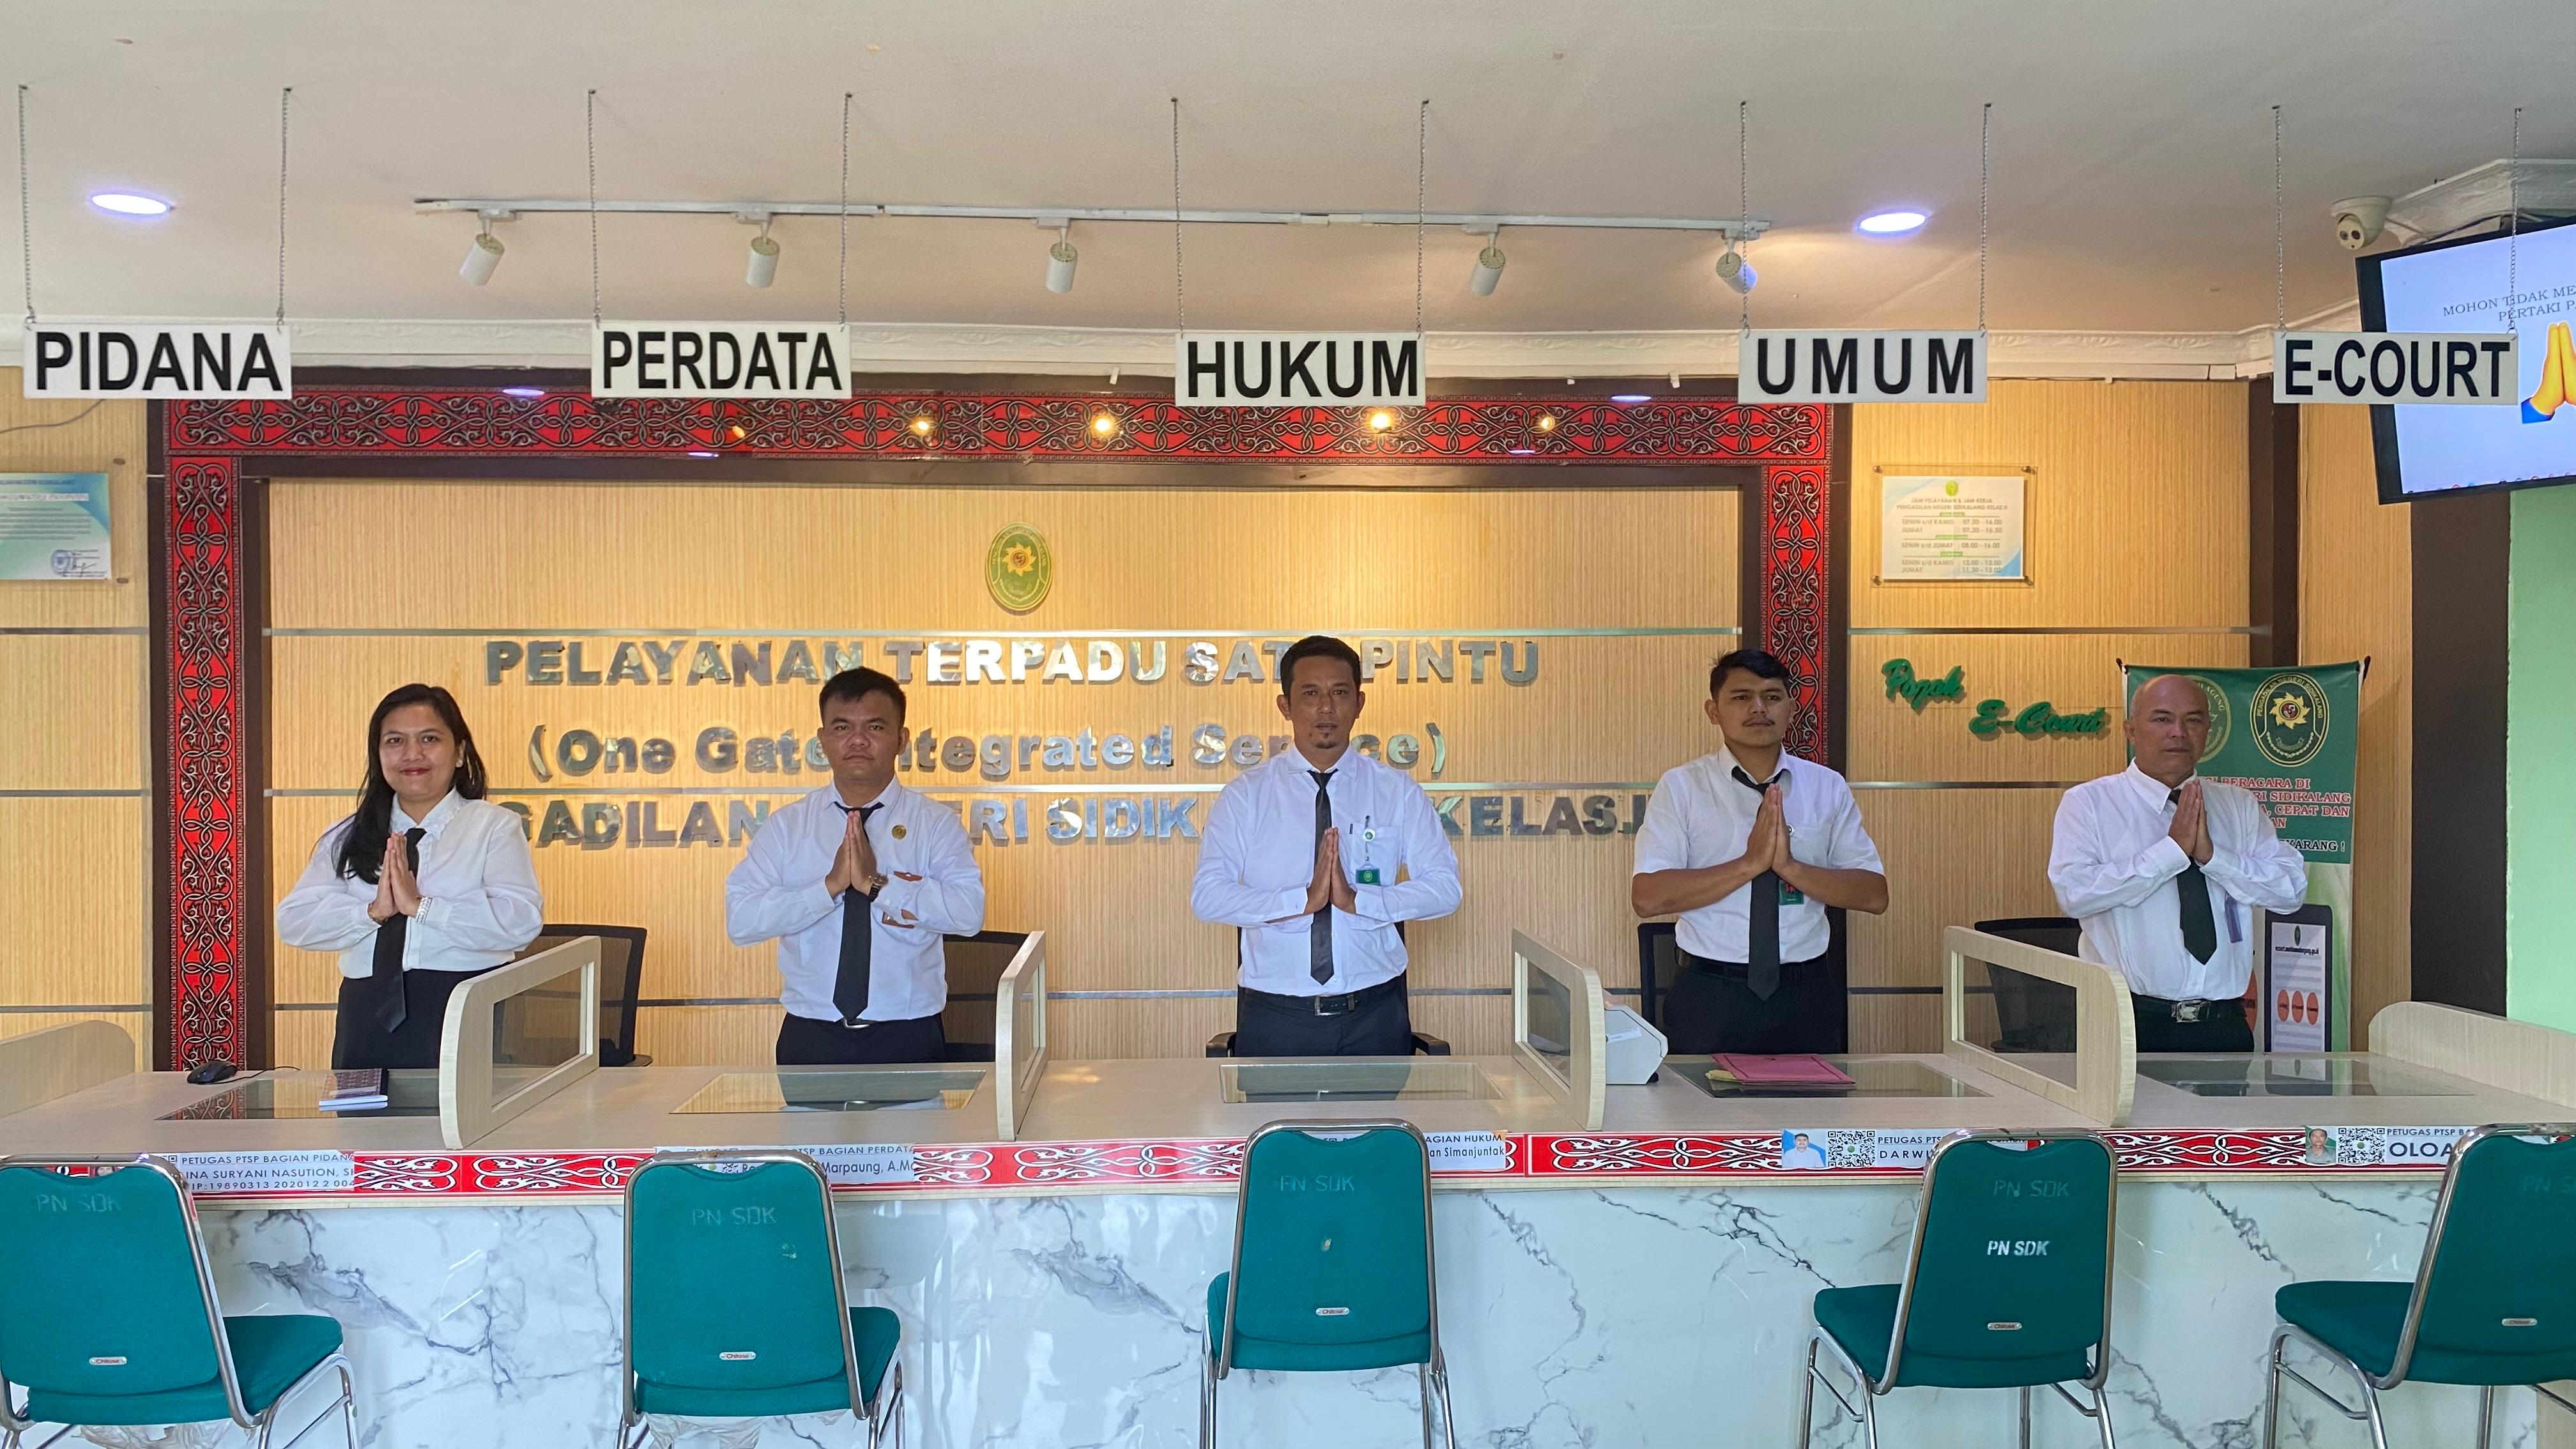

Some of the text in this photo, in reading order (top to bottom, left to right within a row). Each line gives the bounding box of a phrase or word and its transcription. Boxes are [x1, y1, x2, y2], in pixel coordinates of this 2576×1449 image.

[2443, 298, 2498, 316] MOHON
[2503, 289, 2548, 307] TIDAK
[2499, 300, 2576, 321] PERTAKI P
[36, 332, 283, 392] PIDANA
[603, 331, 842, 390] PERDATA
[1188, 340, 1417, 399] HUKUM
[1758, 338, 1974, 395] UMUM
[2285, 339, 2510, 397] E-COURT
[486, 640, 1539, 686] PELAYANAN TERPADU SAT PINTU
[2257, 681, 2279, 717] PENGADILAN
[2304, 682, 2324, 719] SIDIKALANG
[528, 724, 676, 782] (One
[1192, 723, 1446, 774] Serce)
[2221, 777, 2292, 789] BERACARA
[2295, 778, 2310, 790] DI
[2270, 792, 2351, 803] SIDIKALANG
[2274, 805, 2319, 816] CEPAT
[2321, 806, 2350, 817] DAN
[1046, 797, 1201, 845] SIDIK
[1464, 1134, 1502, 1142] HUKUM
[819, 1147, 864, 1155] BAGIAN
[1445, 1146, 1505, 1159] Simanjuntak
[1879, 1150, 1929, 1158] DARWI
[2389, 1142, 2453, 1157] OLOA
[181, 1156, 231, 1165] PETUGAS
[235, 1155, 259, 1164] PTSP
[263, 1154, 309, 1163] BAGIAN
[212, 1169, 267, 1179] SURYANI
[272, 1167, 339, 1177] NASUTION,
[192, 1181, 270, 1190] IP:19890313
[1993, 1179, 2069, 1197] PN SDK
[36, 1193, 68, 1212] PN
[691, 1206, 777, 1226] PN SDK
[1987, 1240, 2051, 1257] PN SDK
